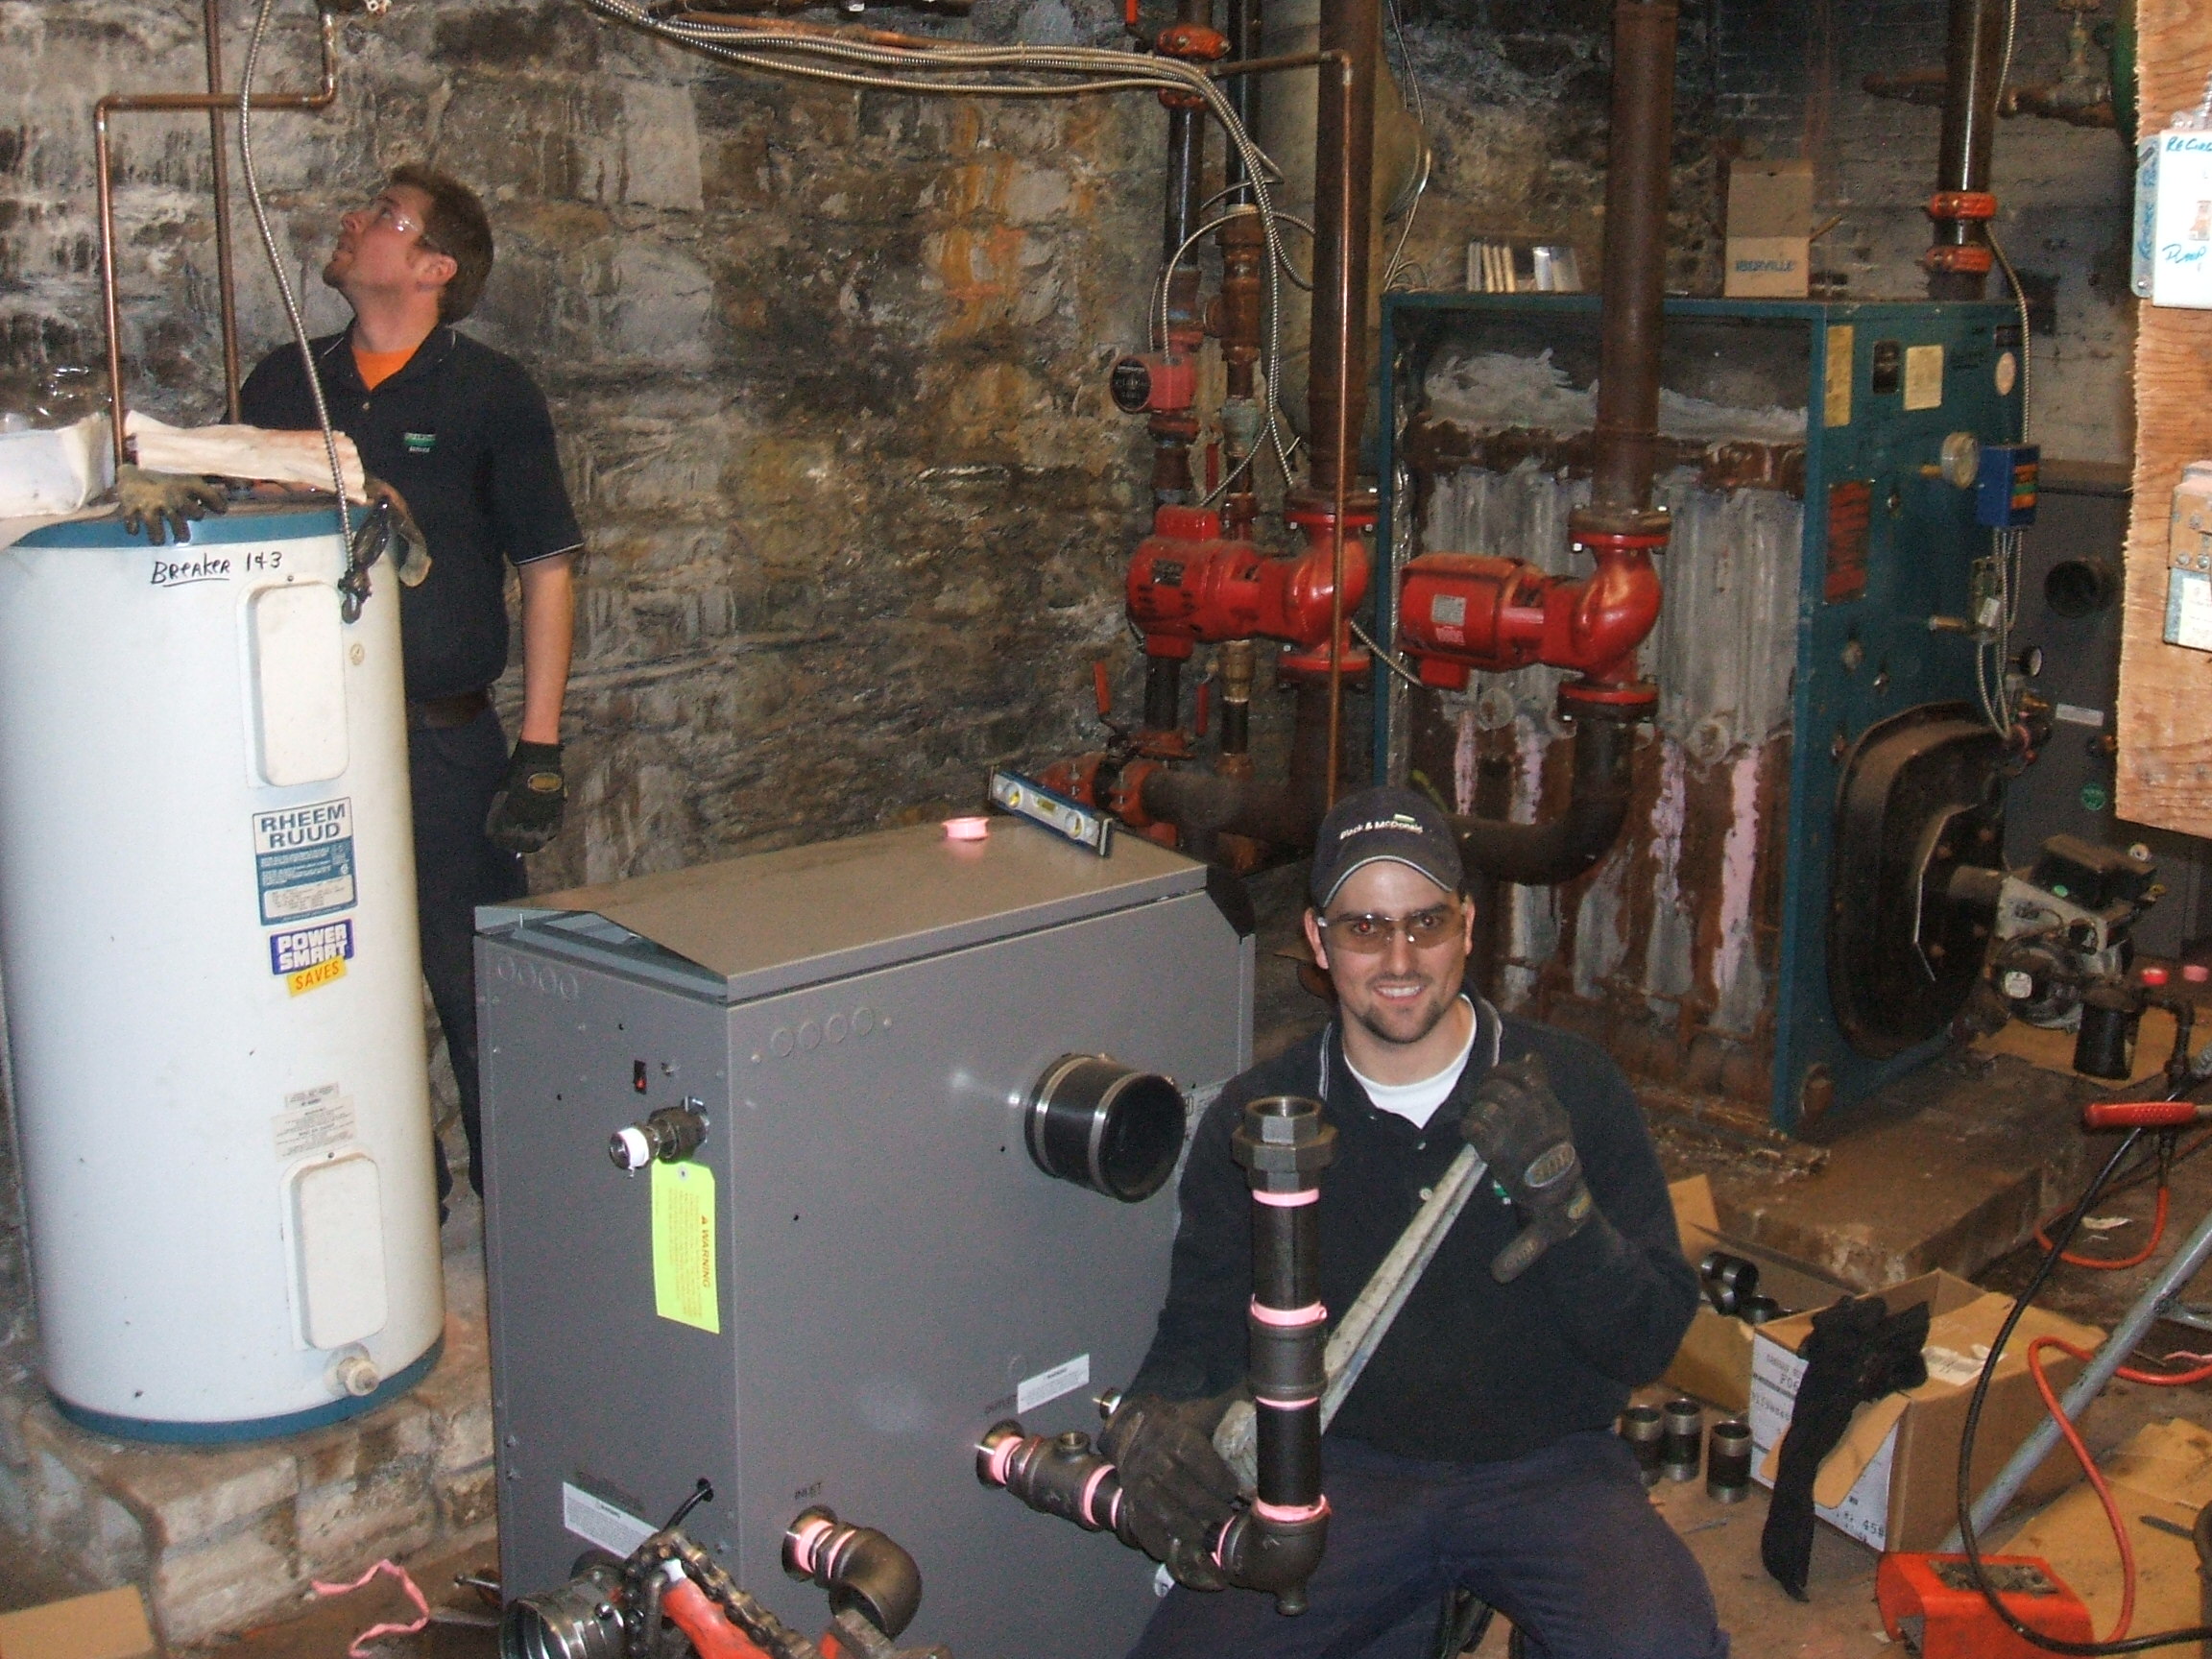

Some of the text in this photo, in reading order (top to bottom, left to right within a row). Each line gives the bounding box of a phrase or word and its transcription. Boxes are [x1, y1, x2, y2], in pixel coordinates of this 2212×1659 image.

[246, 551, 282, 572] 143
[260, 803, 346, 833] RHEEM
[269, 822, 341, 849] RUUD
[277, 923, 348, 953] POWER
[279, 940, 348, 971] SMART
[295, 960, 340, 991] SAVES
[702, 1229, 710, 1288] WARNING
